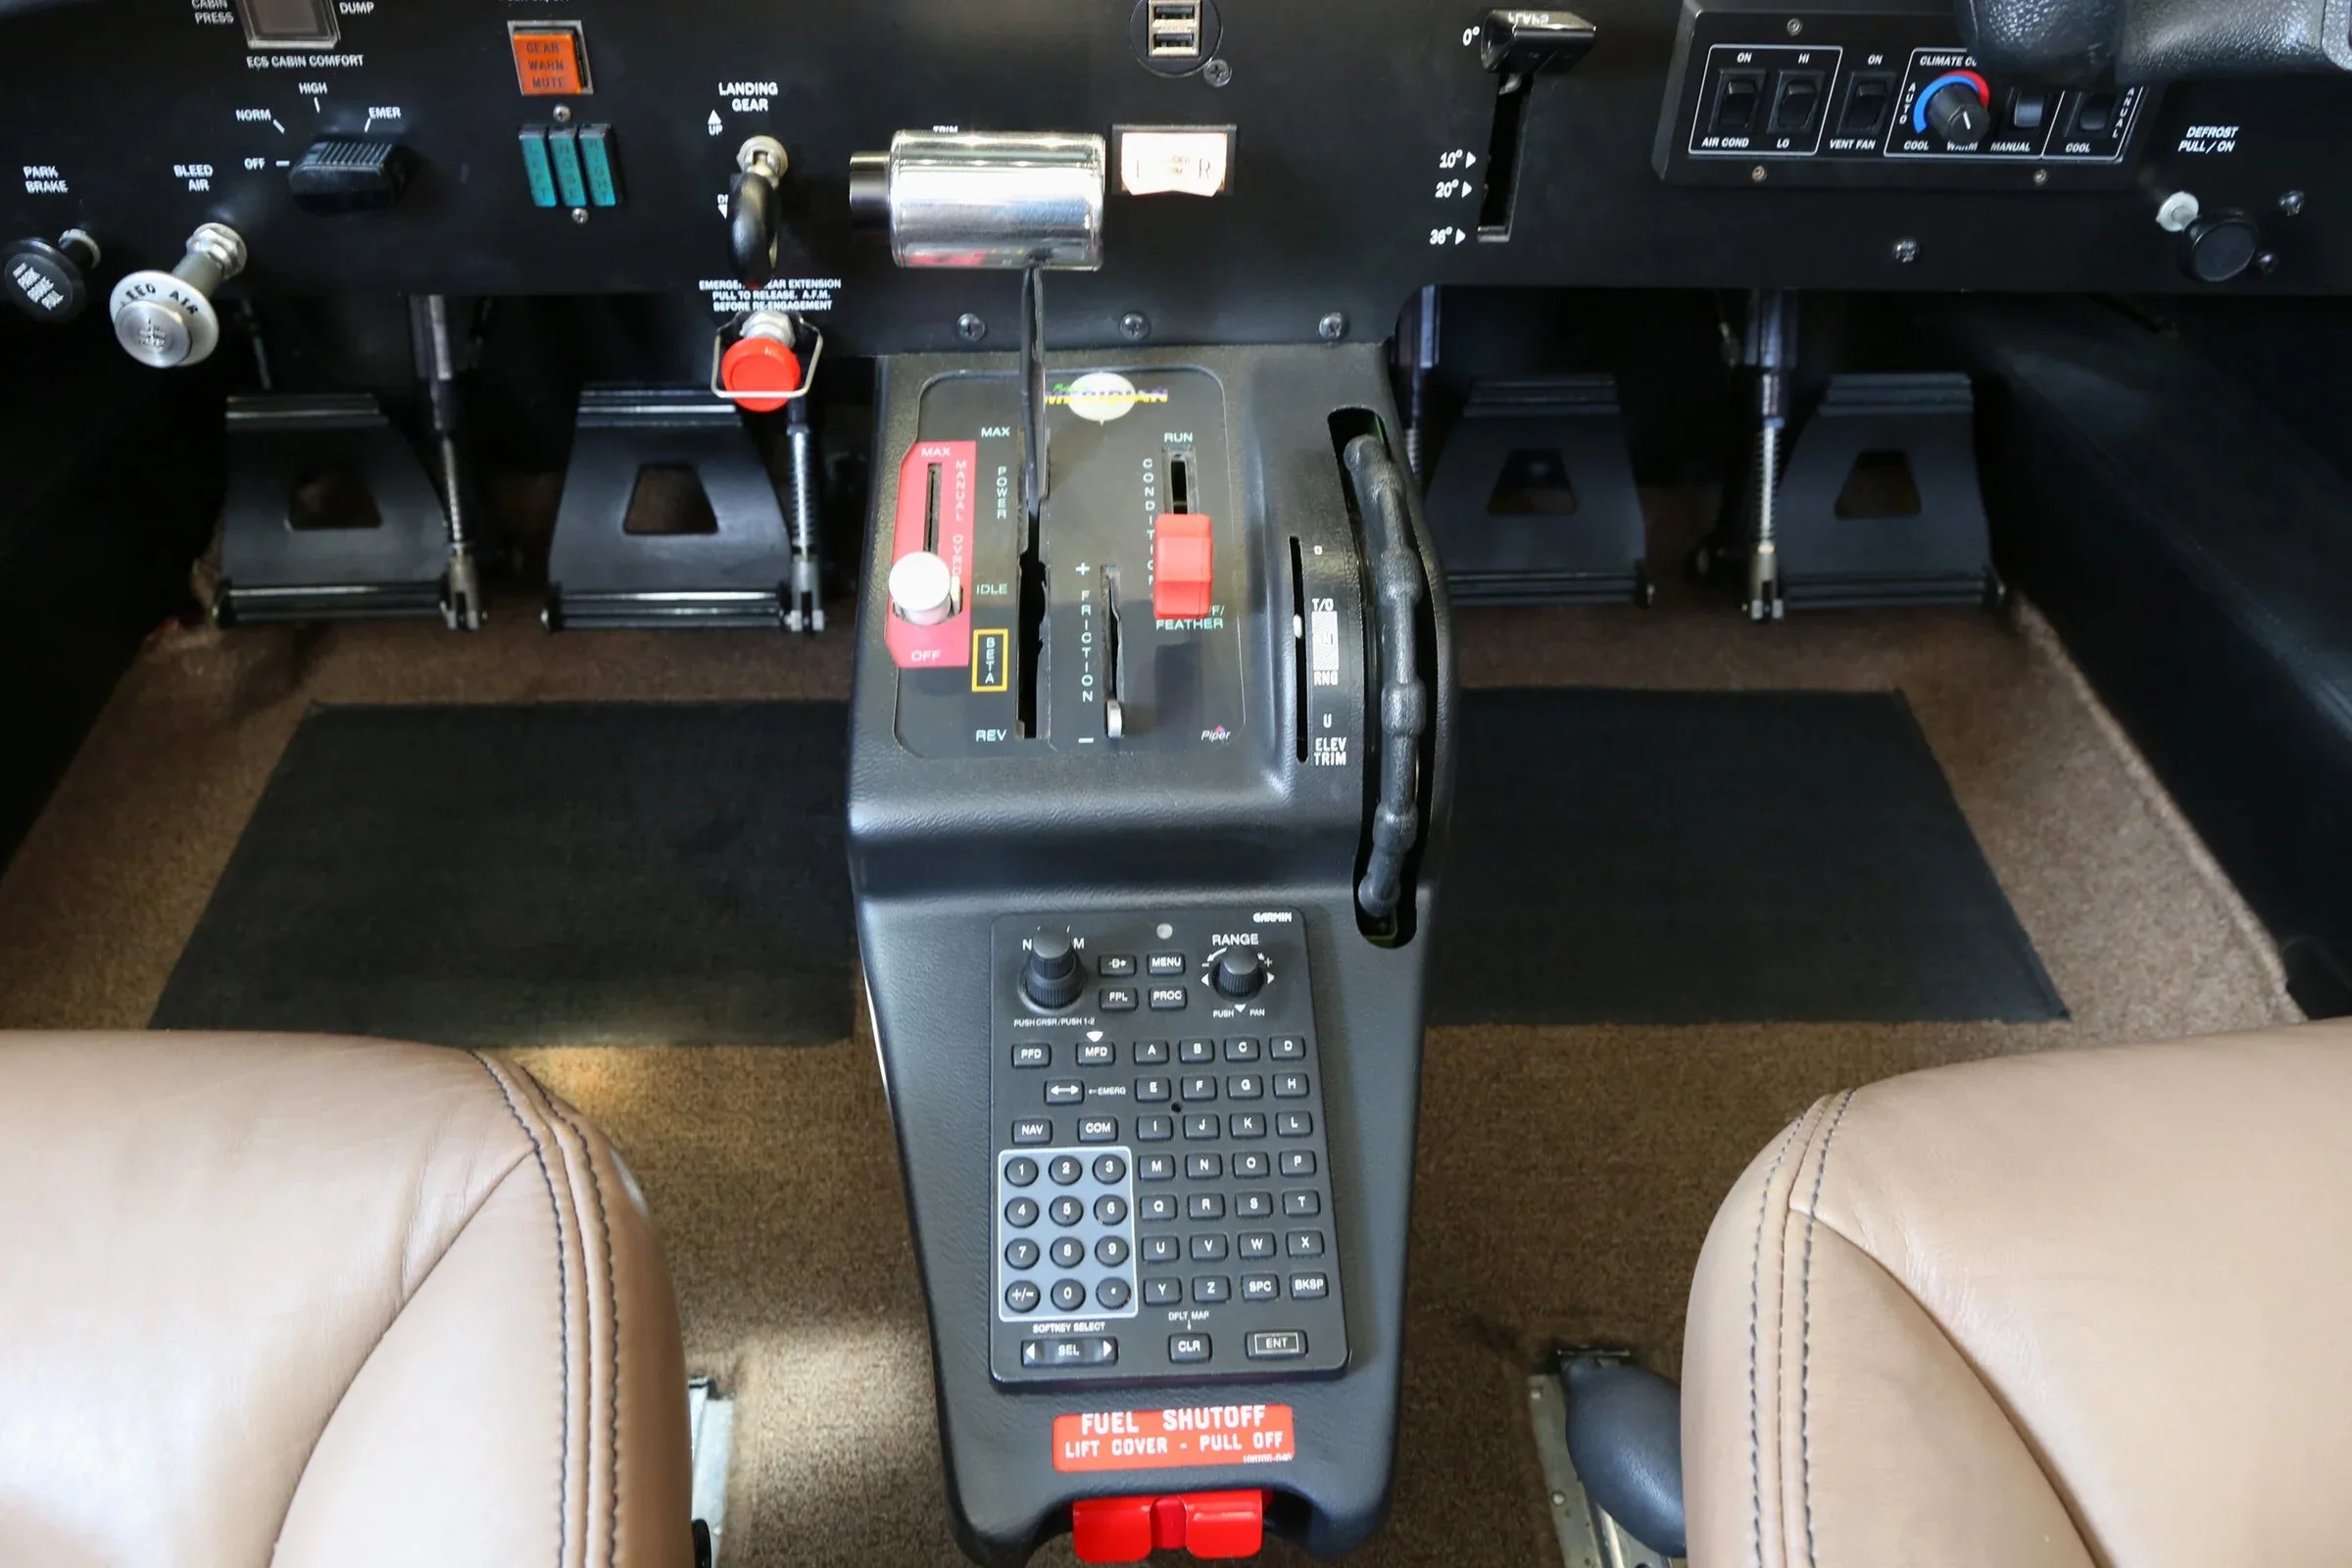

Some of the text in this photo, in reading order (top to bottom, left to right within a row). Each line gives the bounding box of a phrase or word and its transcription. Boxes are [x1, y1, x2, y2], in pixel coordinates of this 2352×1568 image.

[339, 2, 374, 15] DUMP
[195, 12, 235, 24] PRESS
[525, 42, 560, 55] GEAR
[246, 54, 364, 69] ECS CABIN COMFORT
[1737, 52, 1752, 64] ON
[1798, 53, 1810, 64] HI
[1867, 55, 1883, 66] ON
[1920, 56, 1963, 67] CLIMATE
[528, 59, 564, 73] WARN
[299, 82, 327, 94] HIGH
[532, 76, 565, 89] MUTE
[718, 81, 778, 96] LANDING
[731, 98, 768, 112] GEAR
[1899, 82, 1916, 124] AUTO
[235, 109, 272, 122] NORM
[368, 107, 401, 120] EMER
[2112, 87, 2135, 138] ANUAL
[708, 124, 723, 136] UP
[2185, 125, 2239, 138] DEFROST
[1701, 137, 1749, 148] AIR COND
[1776, 138, 1790, 148] LO
[1829, 139, 1876, 150] VENT FAN
[1903, 140, 1930, 151] COOL
[1990, 141, 2031, 153] MANUAL
[2065, 142, 2091, 154] COOL
[244, 158, 266, 170] OFF
[23, 166, 59, 179] PARK
[173, 164, 214, 178] BLEED
[25, 180, 69, 194] BRAKE
[188, 178, 210, 191] AIR
[788, 278, 842, 289] EXTENSION
[712, 290, 736, 302] PULL
[739, 290, 752, 301] TO
[713, 300, 751, 312] BEFORE
[980, 426, 1010, 437] MAX
[1164, 432, 1193, 443] RUN
[921, 447, 951, 458] MAX
[956, 460, 966, 521] MANUAL
[996, 466, 1008, 520] POWER
[976, 583, 1007, 595] IDLE
[1311, 598, 1335, 612] T/O
[1155, 617, 1224, 631] FEATHER
[1080, 590, 1094, 703] FRICTION
[910, 650, 942, 662] OFF
[985, 637, 996, 684] BETA
[1313, 670, 1339, 686] RNG
[1323, 713, 1333, 729] U
[975, 729, 1007, 742] REV
[1200, 728, 1231, 742] Piper
[1315, 737, 1347, 752] ELEV
[1313, 752, 1347, 766] TRIM
[1252, 912, 1293, 923] GARMIN
[1022, 938, 1032, 952] N
[1073, 937, 1085, 950] M
[1211, 933, 1259, 946] RANGE
[1152, 956, 1182, 968] MENU
[1109, 991, 1128, 1003] FPL
[1152, 990, 1183, 1002] PROC
[1212, 1009, 1235, 1018] PUSH
[1250, 1008, 1266, 1017] PAN
[1085, 1047, 1108, 1057] MFD
[1148, 1044, 1156, 1055] A
[1193, 1043, 1201, 1054] B
[1238, 1042, 1248, 1054] C
[1284, 1040, 1293, 1052] D
[1021, 1049, 1042, 1059] PFD
[1150, 1081, 1157, 1094] E
[1196, 1080, 1203, 1093] F
[1241, 1079, 1250, 1091] G
[1288, 1078, 1297, 1090] H
[1098, 1086, 1126, 1097] EMERG
[1085, 1122, 1111, 1134] COM
[1199, 1118, 1205, 1131] J
[1244, 1117, 1252, 1129] K
[1291, 1116, 1298, 1128] L
[1021, 1124, 1043, 1136] NAV
[1105, 1160, 1113, 1173] 3
[1152, 1160, 1162, 1172] M
[1200, 1159, 1209, 1171] N
[1294, 1155, 1302, 1167] P
[1019, 1163, 1024, 1176] 1
[1062, 1161, 1070, 1175] 2
[1063, 1201, 1071, 1215] 5
[1106, 1201, 1115, 1214] 6
[1153, 1200, 1164, 1212] Q
[1201, 1199, 1211, 1210] R
[1250, 1198, 1258, 1209] S
[1298, 1196, 1306, 1208] T
[1017, 1203, 1026, 1216] 4
[1155, 1242, 1165, 1253] U
[1203, 1240, 1213, 1252] V
[1250, 1238, 1263, 1250] W
[1300, 1236, 1310, 1249] X
[1018, 1246, 1027, 1258] 7
[1063, 1244, 1072, 1256] 8
[1108, 1243, 1117, 1255] 9
[1157, 1284, 1166, 1296] Y
[1206, 1282, 1216, 1295] Z
[1249, 1280, 1272, 1293] SPC
[1295, 1278, 1324, 1291] BKSP
[1191, 1310, 1209, 1320] MAP
[1033, 1321, 1106, 1333] SOFTKEY SELECT
[1178, 1341, 1200, 1352] CLR
[1266, 1338, 1288, 1349] ENT
[1057, 1345, 1080, 1356] SEL
[1081, 1404, 1266, 1436] FUEL SHUTOFF
[1064, 1440, 1101, 1459] LIFT
[1111, 1437, 1168, 1456] COVER
[1200, 1434, 1243, 1452] PULL
[1252, 1431, 1284, 1449] OFF
